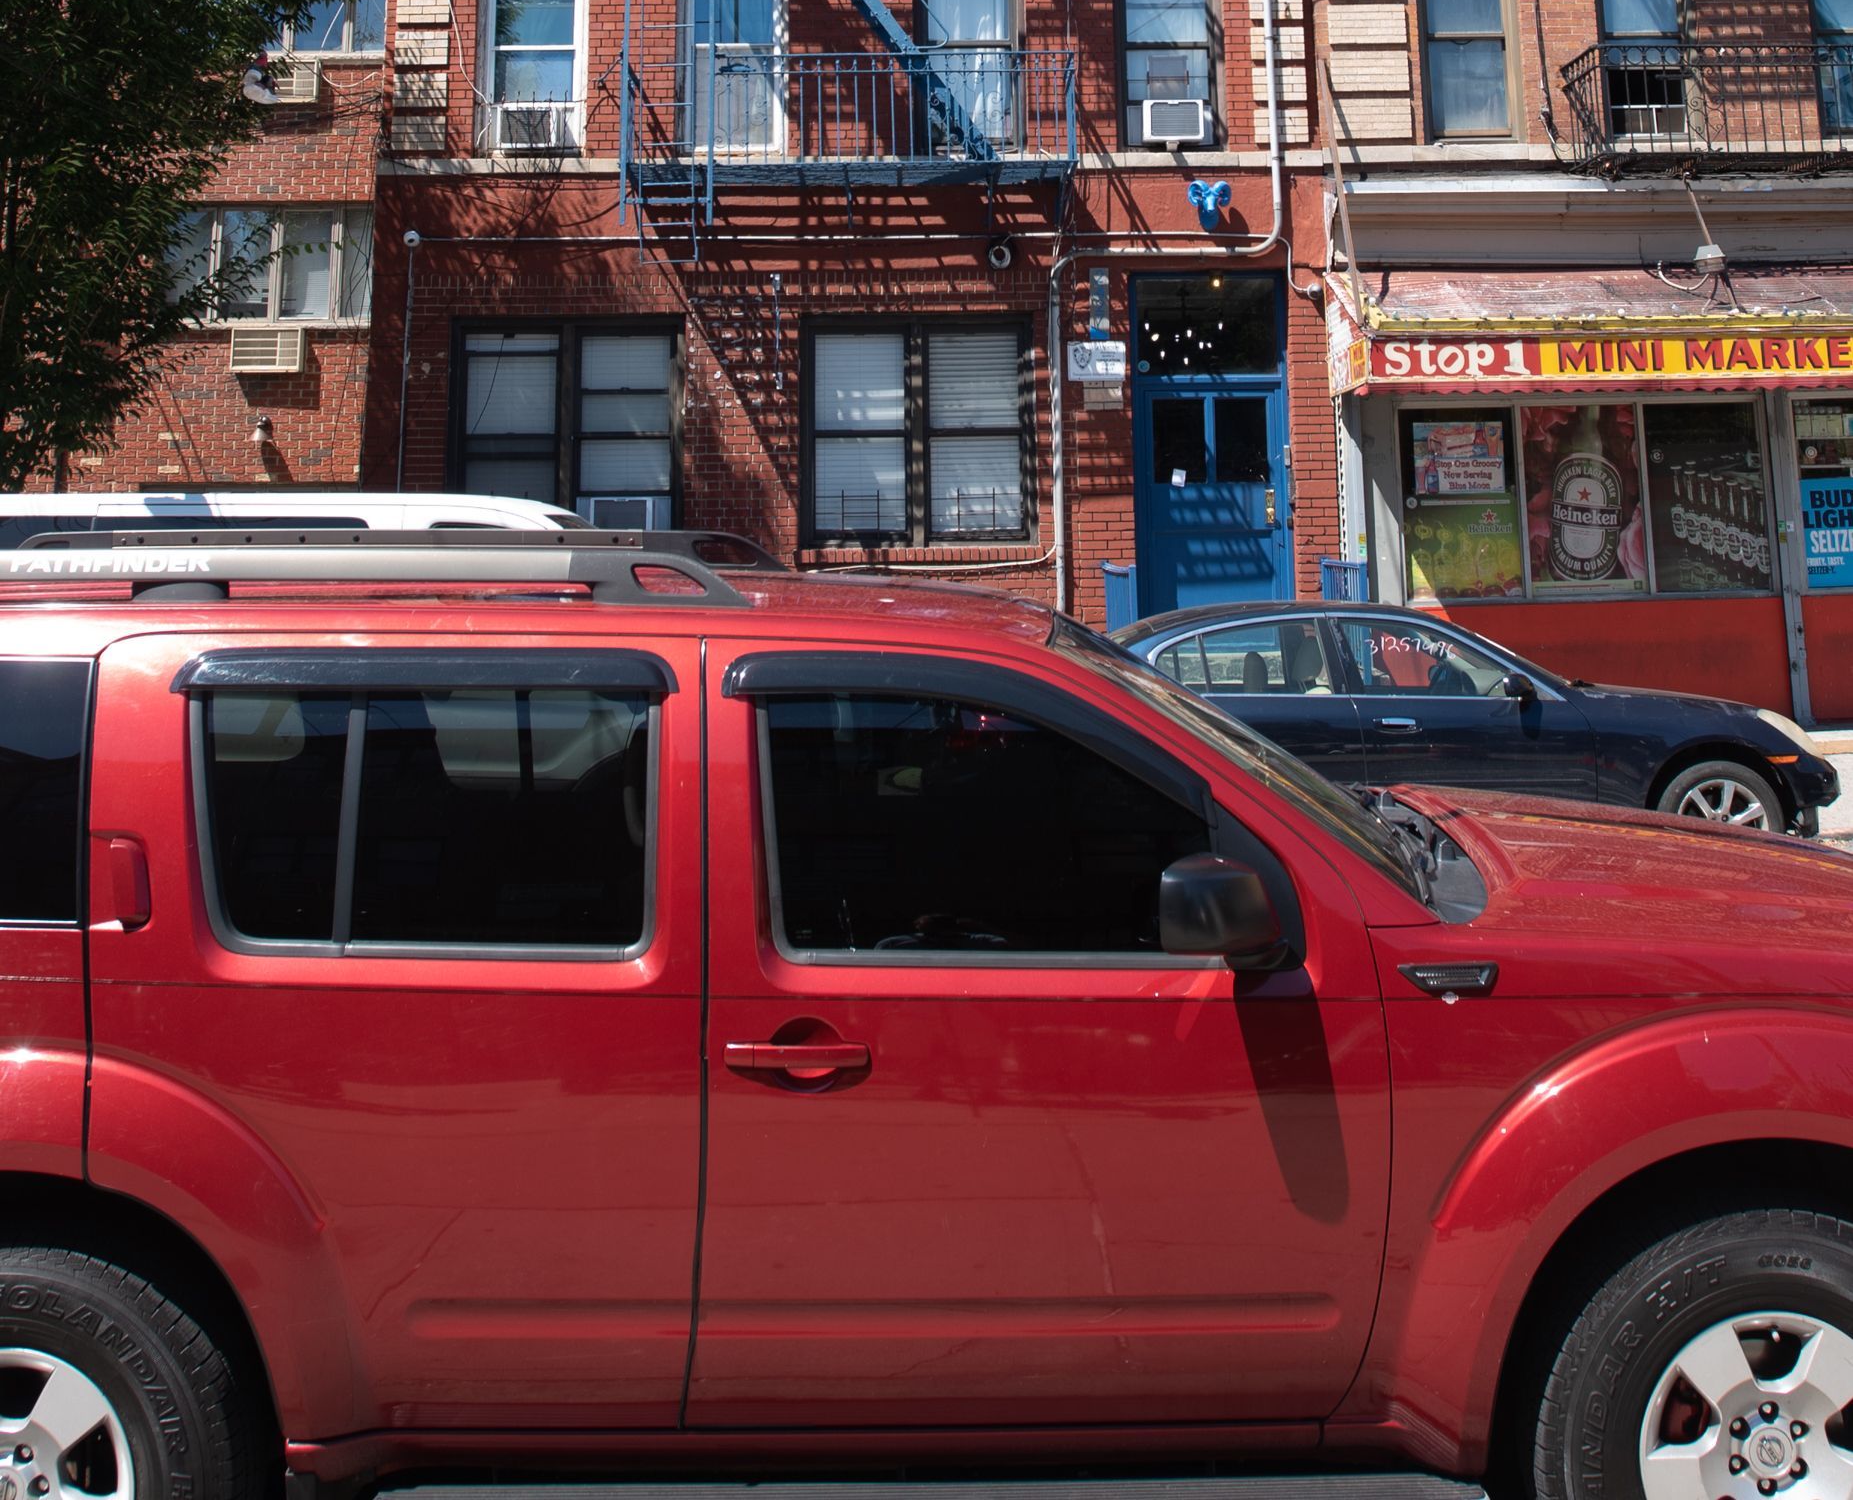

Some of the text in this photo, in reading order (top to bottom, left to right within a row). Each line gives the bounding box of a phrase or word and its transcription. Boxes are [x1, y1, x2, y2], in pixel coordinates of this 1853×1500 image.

[1384, 339, 1495, 376] Stop
[1503, 339, 1531, 376] 1
[1559, 340, 1665, 372] MINI
[1685, 336, 1853, 370] MARKE
[1435, 460, 1502, 470] Stop One Grocery
[1443, 471, 1493, 480] Now Serving
[1583, 465, 1607, 482] LAGER
[1605, 476, 1617, 498] BEER
[1448, 481, 1490, 490] Blue Moon
[1810, 489, 1853, 508] BUD
[1552, 503, 1618, 525] Heineken
[1468, 522, 1512, 534] Heineken
[9, 553, 210, 572] PATHFINDER
[1553, 537, 1614, 572] PREMIUM QUALITY
